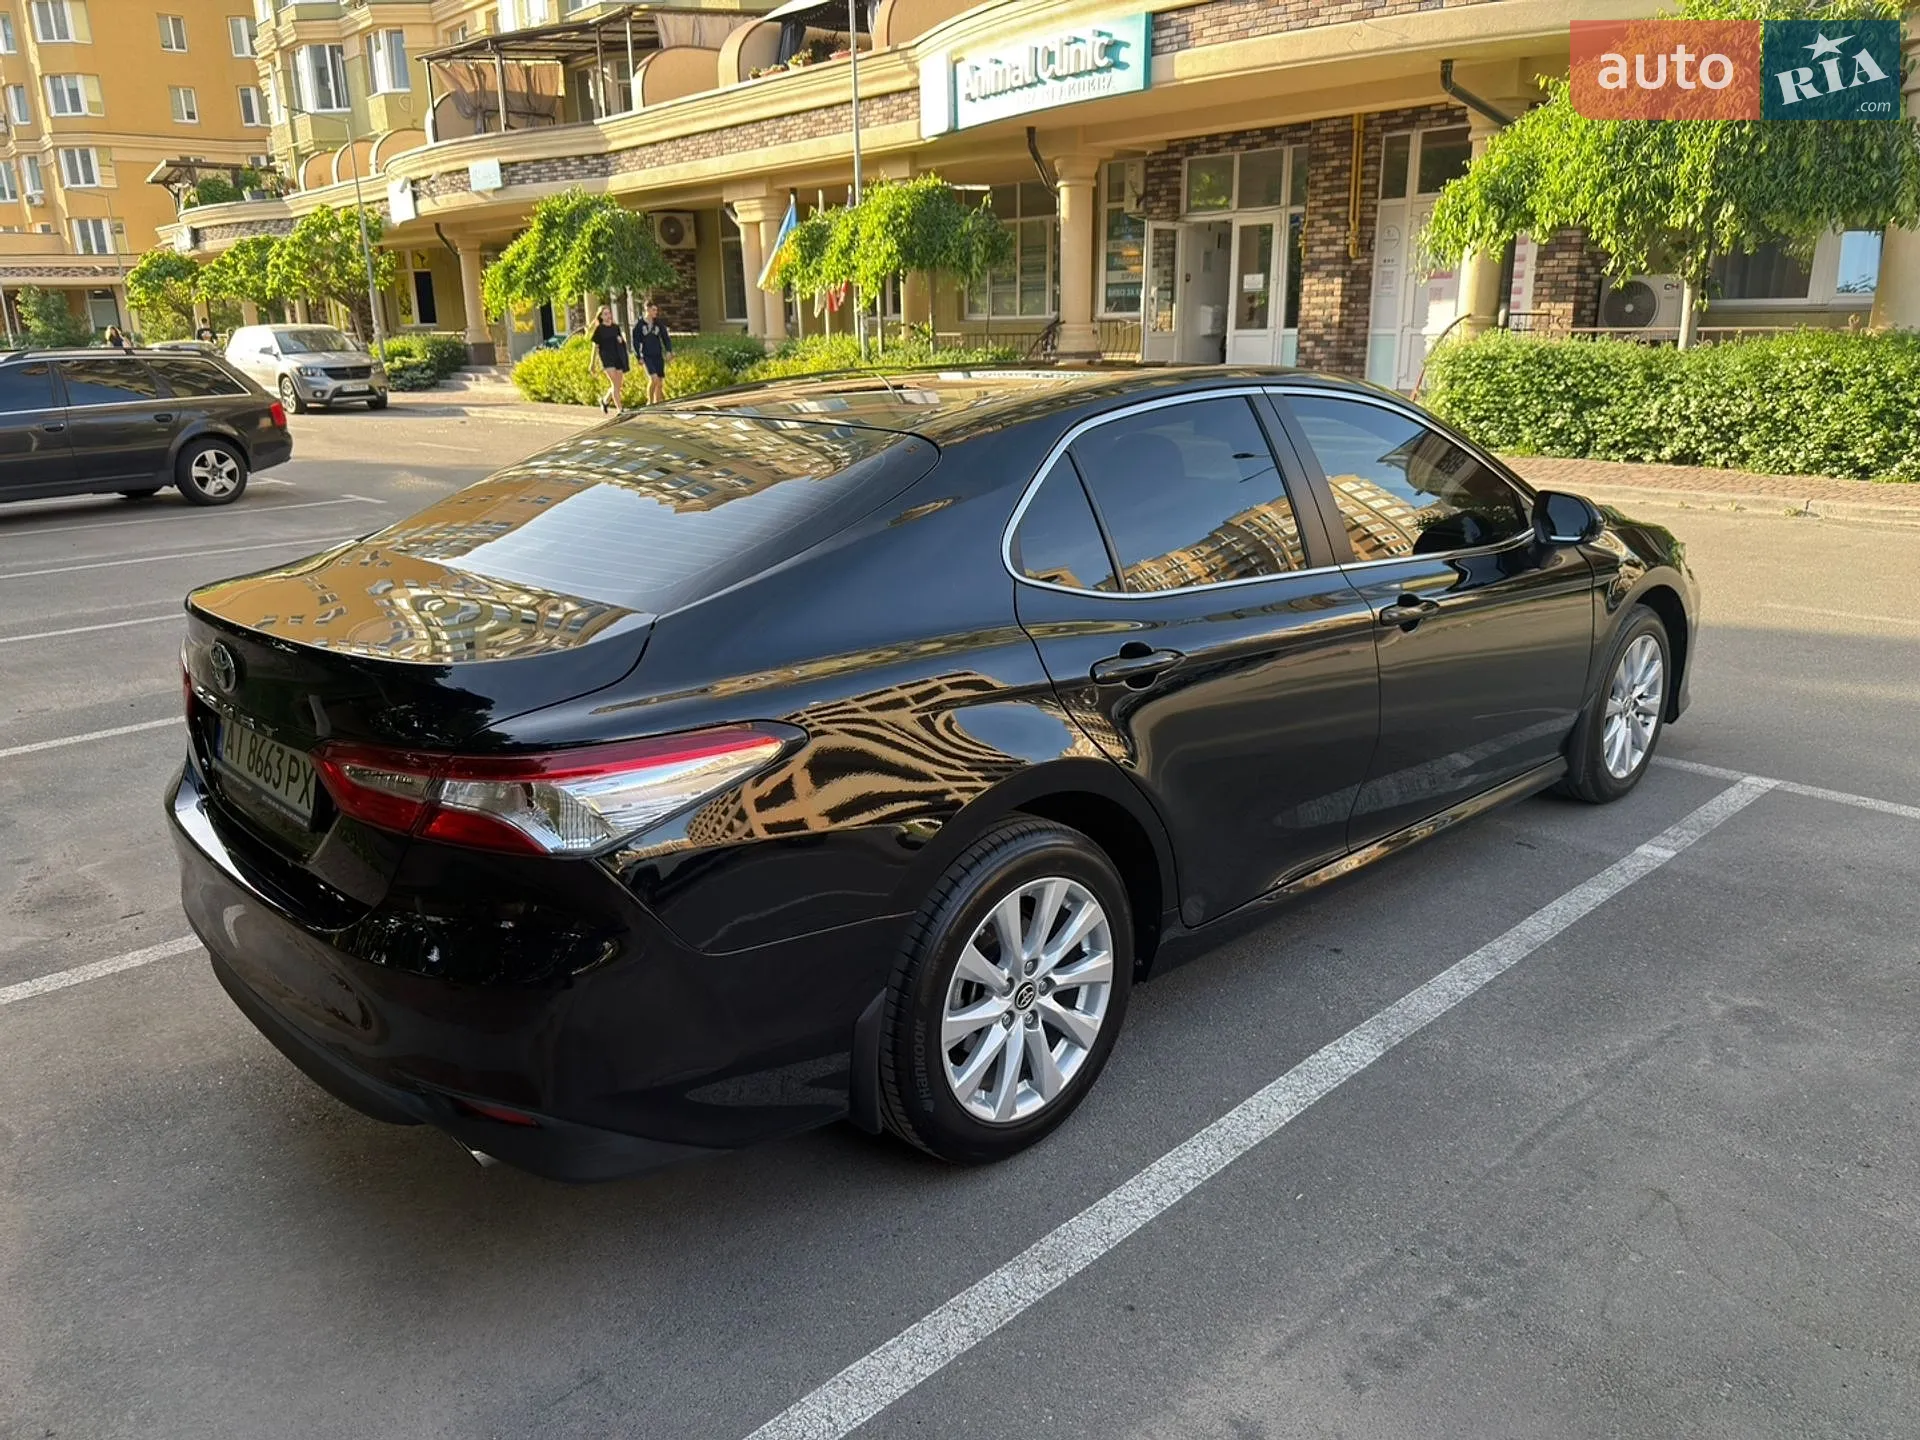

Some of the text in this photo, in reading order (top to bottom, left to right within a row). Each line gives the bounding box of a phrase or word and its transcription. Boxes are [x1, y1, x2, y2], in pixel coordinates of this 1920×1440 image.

[965, 45, 1042, 102] Animal
[1038, 29, 1116, 81] Clinic
[247, 733, 284, 790] 8663
[284, 757, 316, 810] PX
